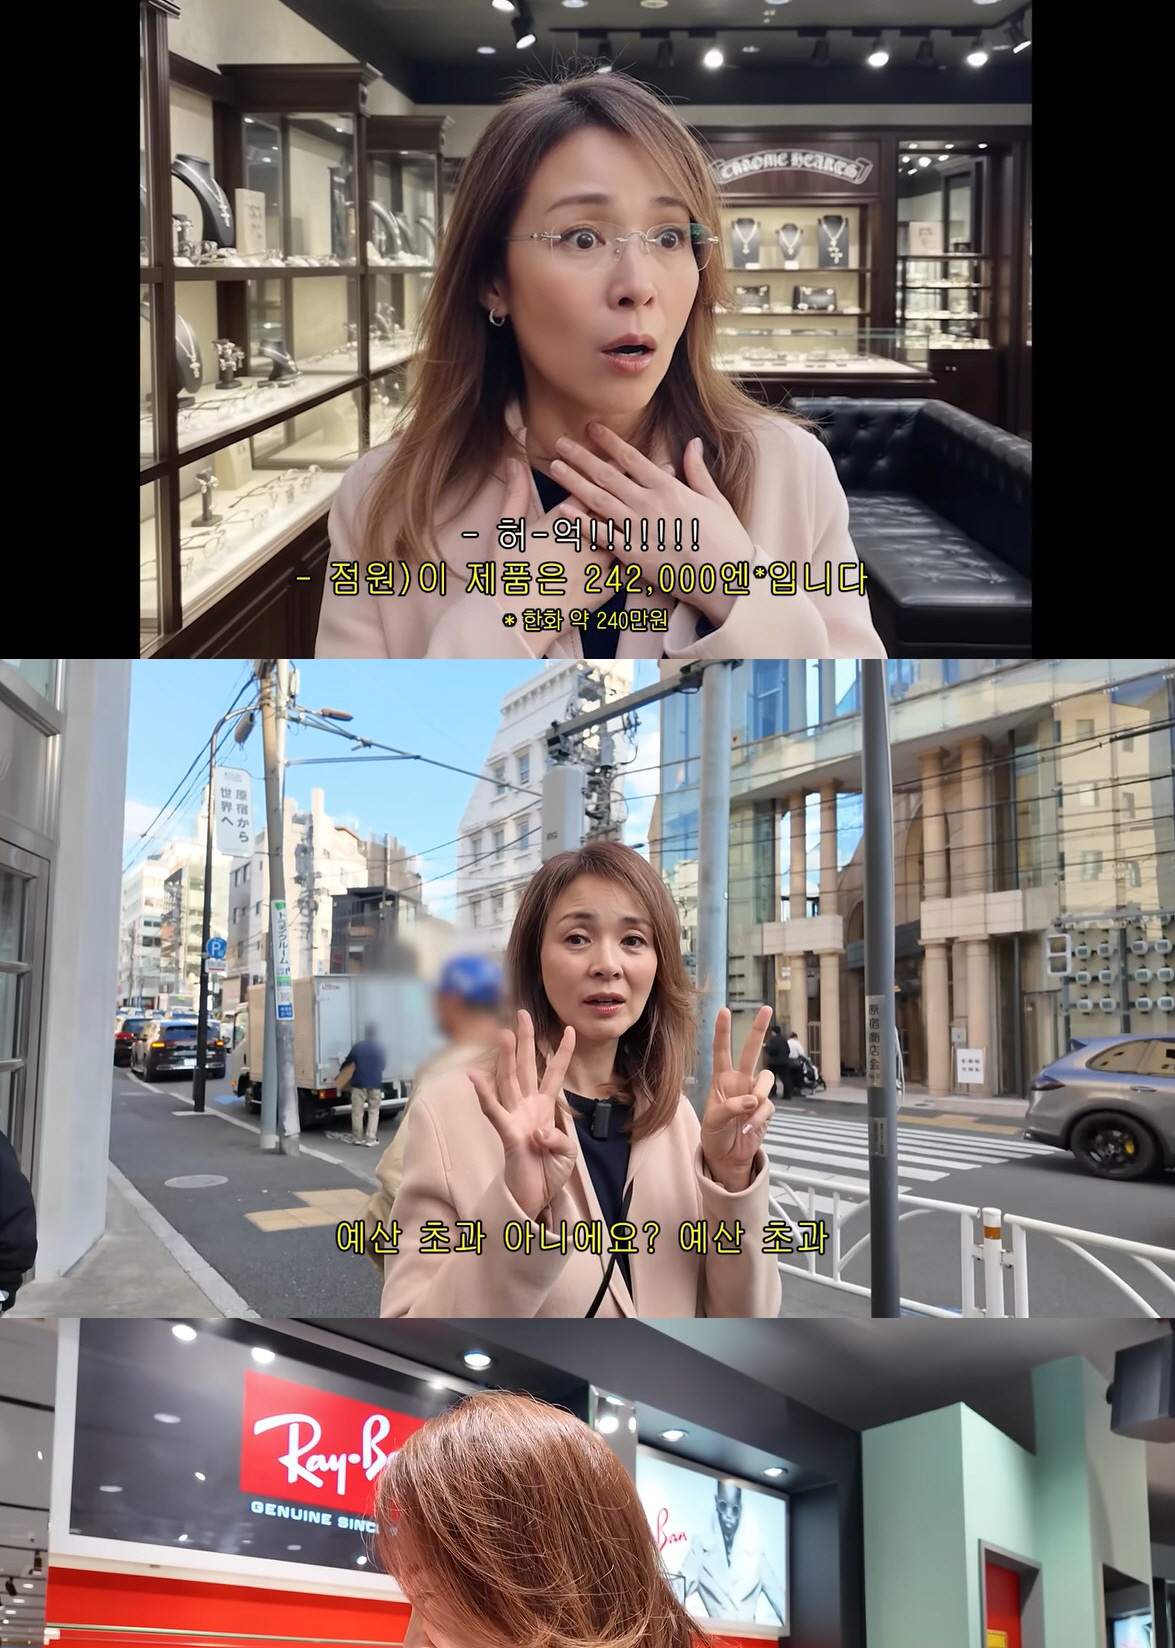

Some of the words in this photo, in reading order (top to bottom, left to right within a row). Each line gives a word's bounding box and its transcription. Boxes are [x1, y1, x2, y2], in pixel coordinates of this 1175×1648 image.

[220, 787, 234, 826] 世界へ
[211, 945, 221, 958] P
[868, 1004, 880, 1071] 原宿商店会
[254, 1413, 398, 1496] Ray-B
[250, 1500, 332, 1526] GENUINE
[337, 1516, 380, 1534] SINC
